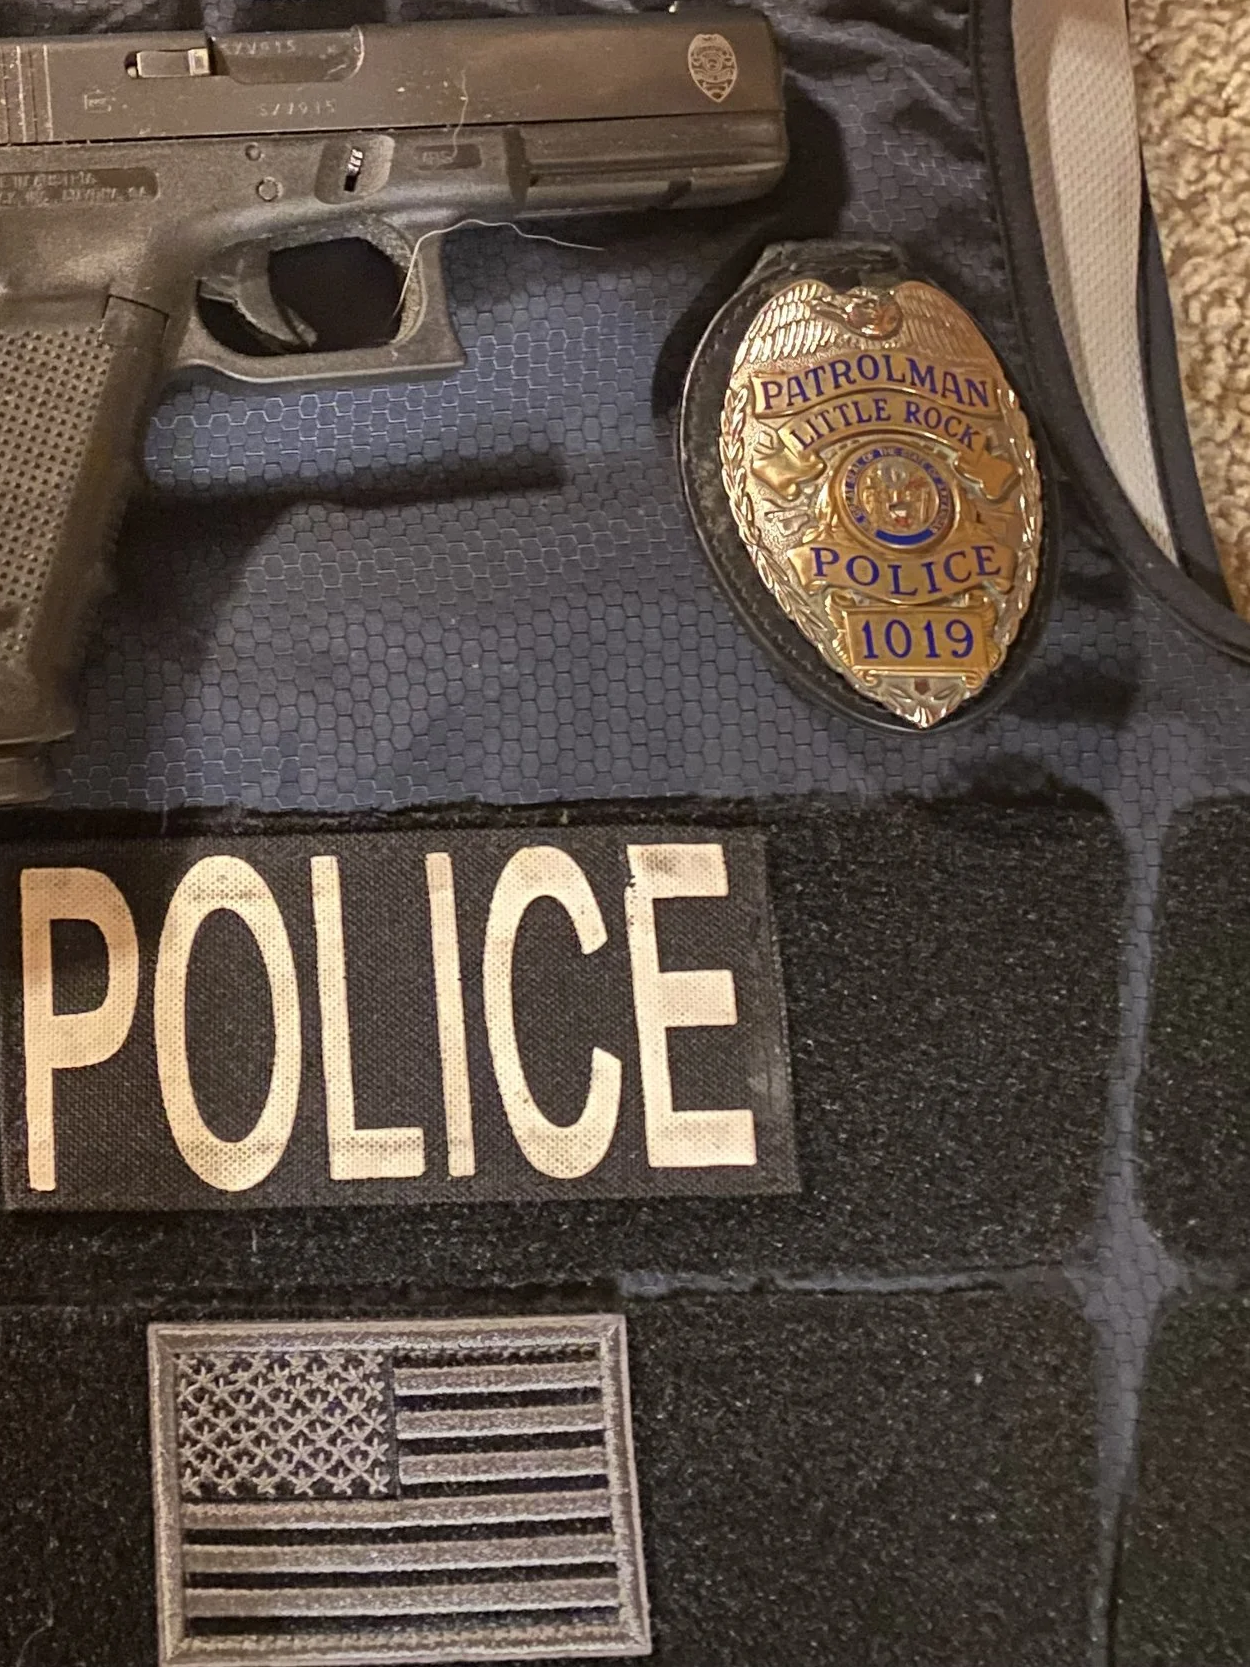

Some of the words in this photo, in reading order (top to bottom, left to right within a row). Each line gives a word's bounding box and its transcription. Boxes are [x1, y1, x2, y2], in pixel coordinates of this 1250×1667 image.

[760, 353, 991, 411] PATROLMAN
[790, 397, 892, 451] LITTLE
[903, 400, 983, 452] ROCK
[810, 545, 1001, 597] POLICE
[861, 619, 975, 659] 1019
[19, 842, 758, 1192] POLICE
